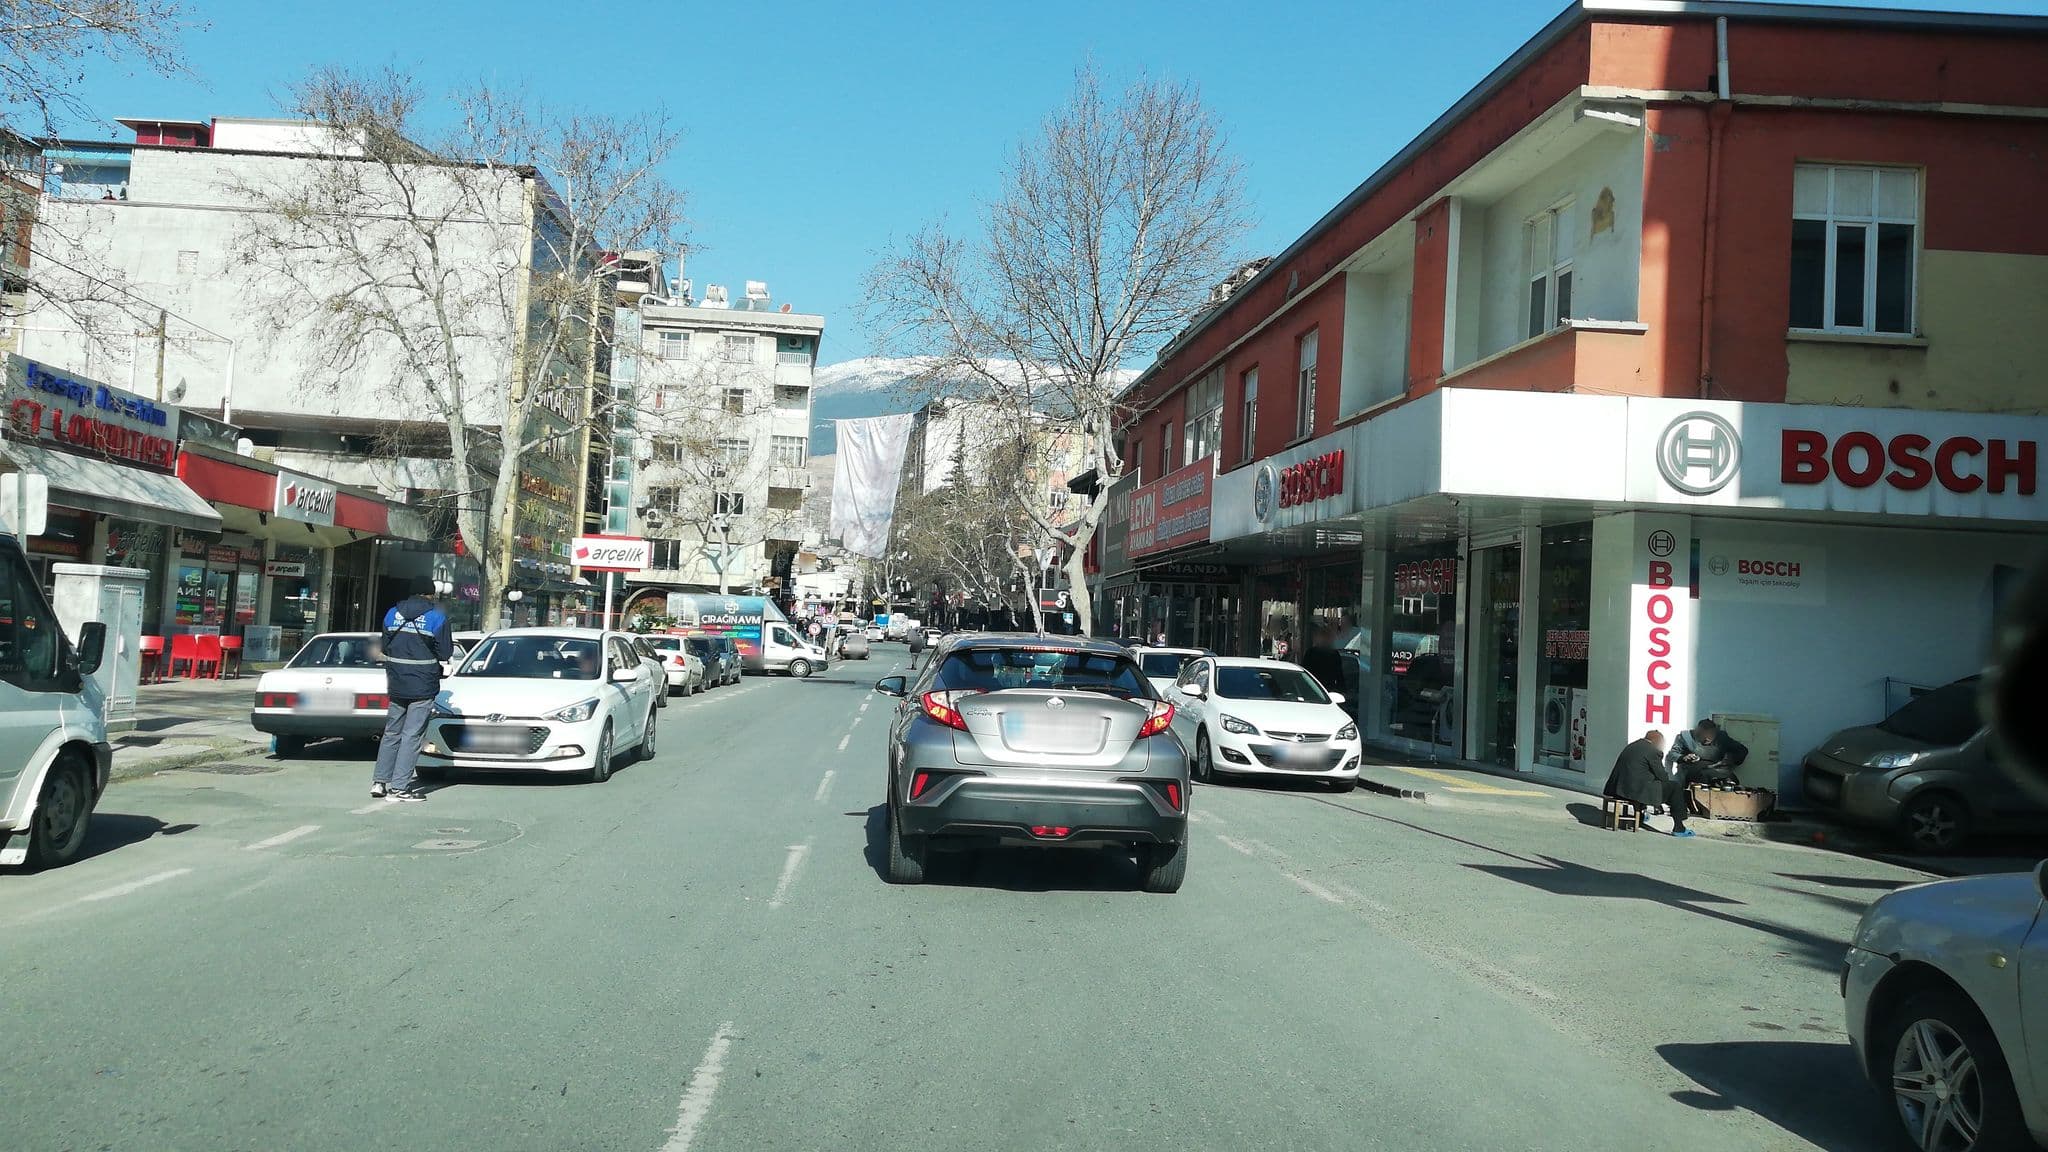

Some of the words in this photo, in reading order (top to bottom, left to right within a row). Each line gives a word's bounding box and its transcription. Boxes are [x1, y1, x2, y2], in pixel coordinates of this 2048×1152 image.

[1279, 448, 1344, 509] BOSCH
[1780, 428, 2037, 496] BOSCH
[296, 486, 333, 517] arçelik
[592, 546, 643, 564] arçelik
[1738, 559, 1801, 577] BOSCH
[1397, 558, 1456, 598] BOSCH
[1645, 560, 1675, 725] BOSCH
